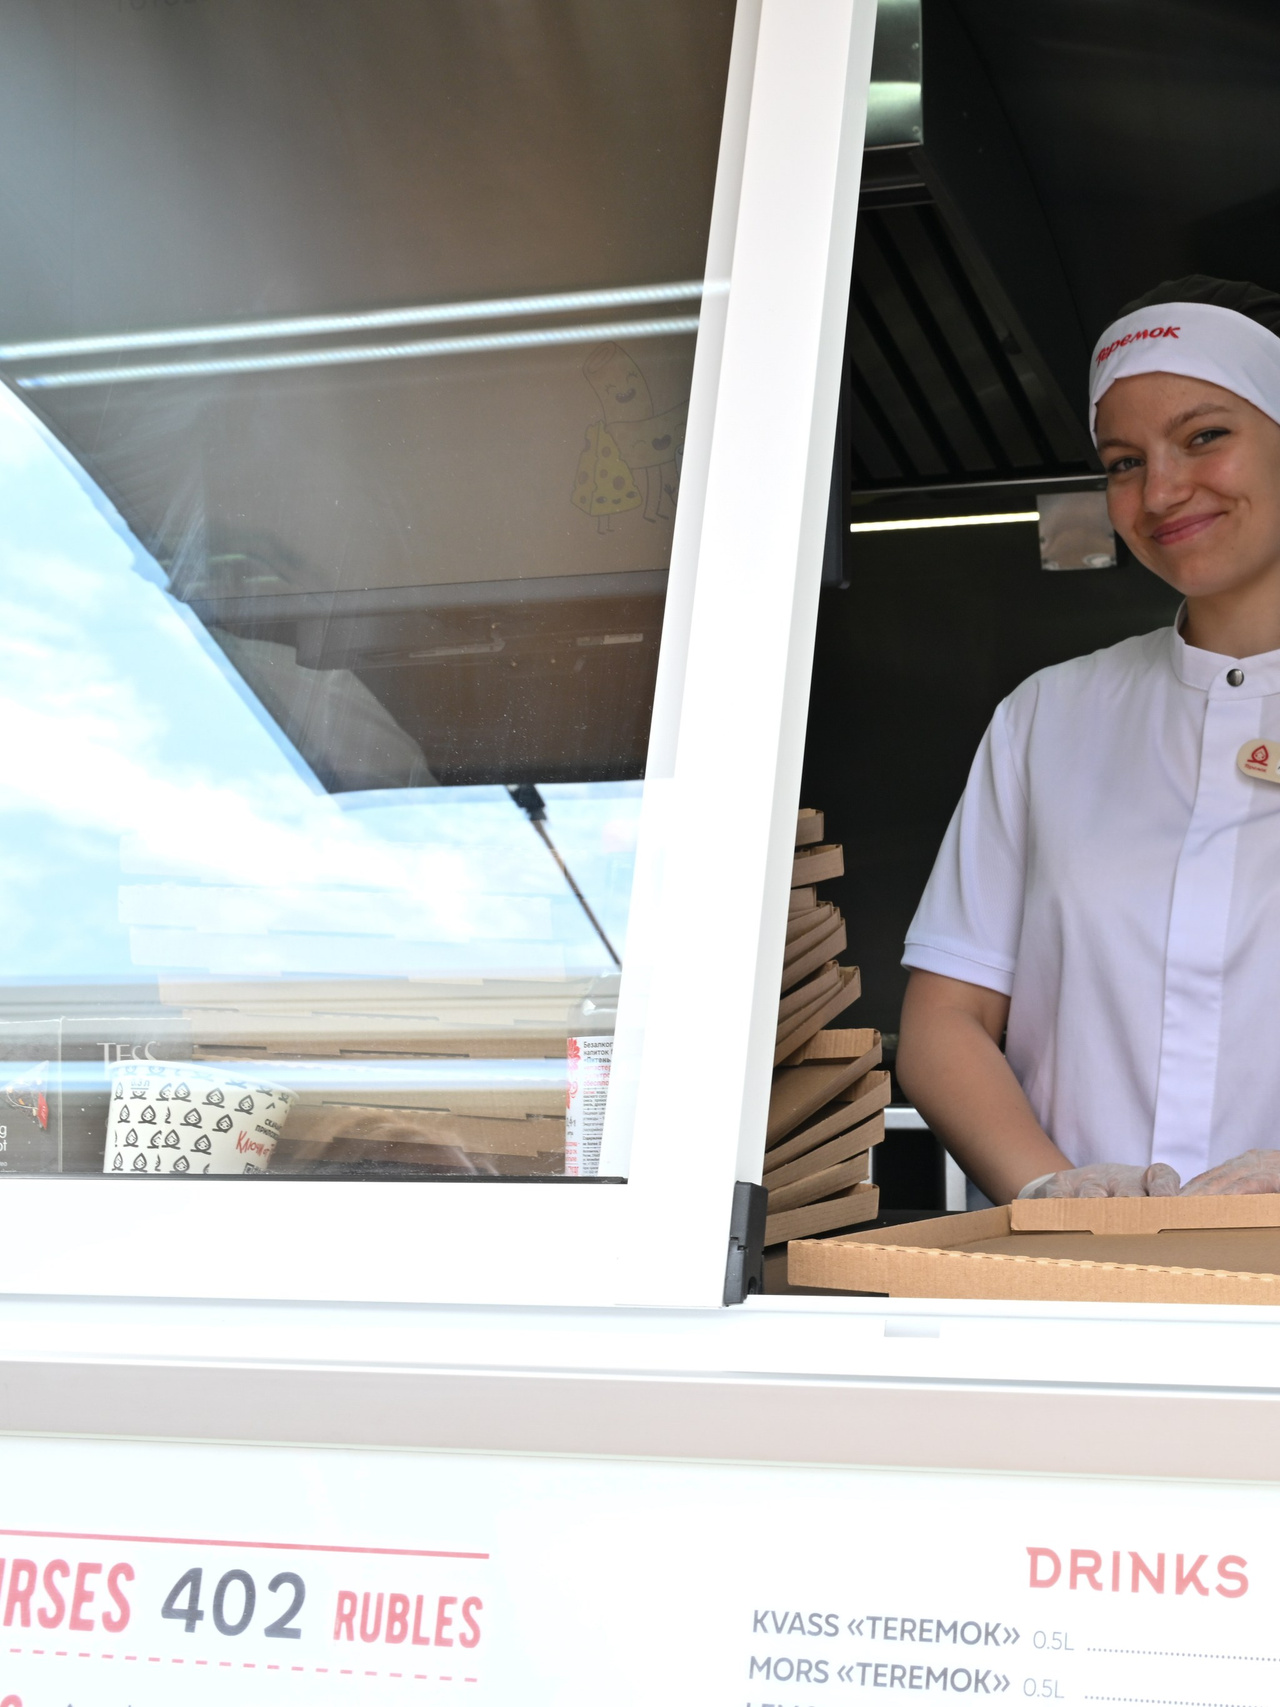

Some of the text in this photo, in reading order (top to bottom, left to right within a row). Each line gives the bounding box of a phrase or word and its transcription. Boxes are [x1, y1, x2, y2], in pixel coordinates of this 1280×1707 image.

[1026, 1546, 1249, 1598] DRINKS
[0, 1558, 483, 1649] RSES 402 RUBLES
[752, 1610, 840, 1637] KVASS
[847, 1616, 1021, 1646] «TEREMOK»
[1033, 1630, 1074, 1651] 0.5L
[749, 1656, 1065, 1698] MORS «TEREMOK» 0.5L
